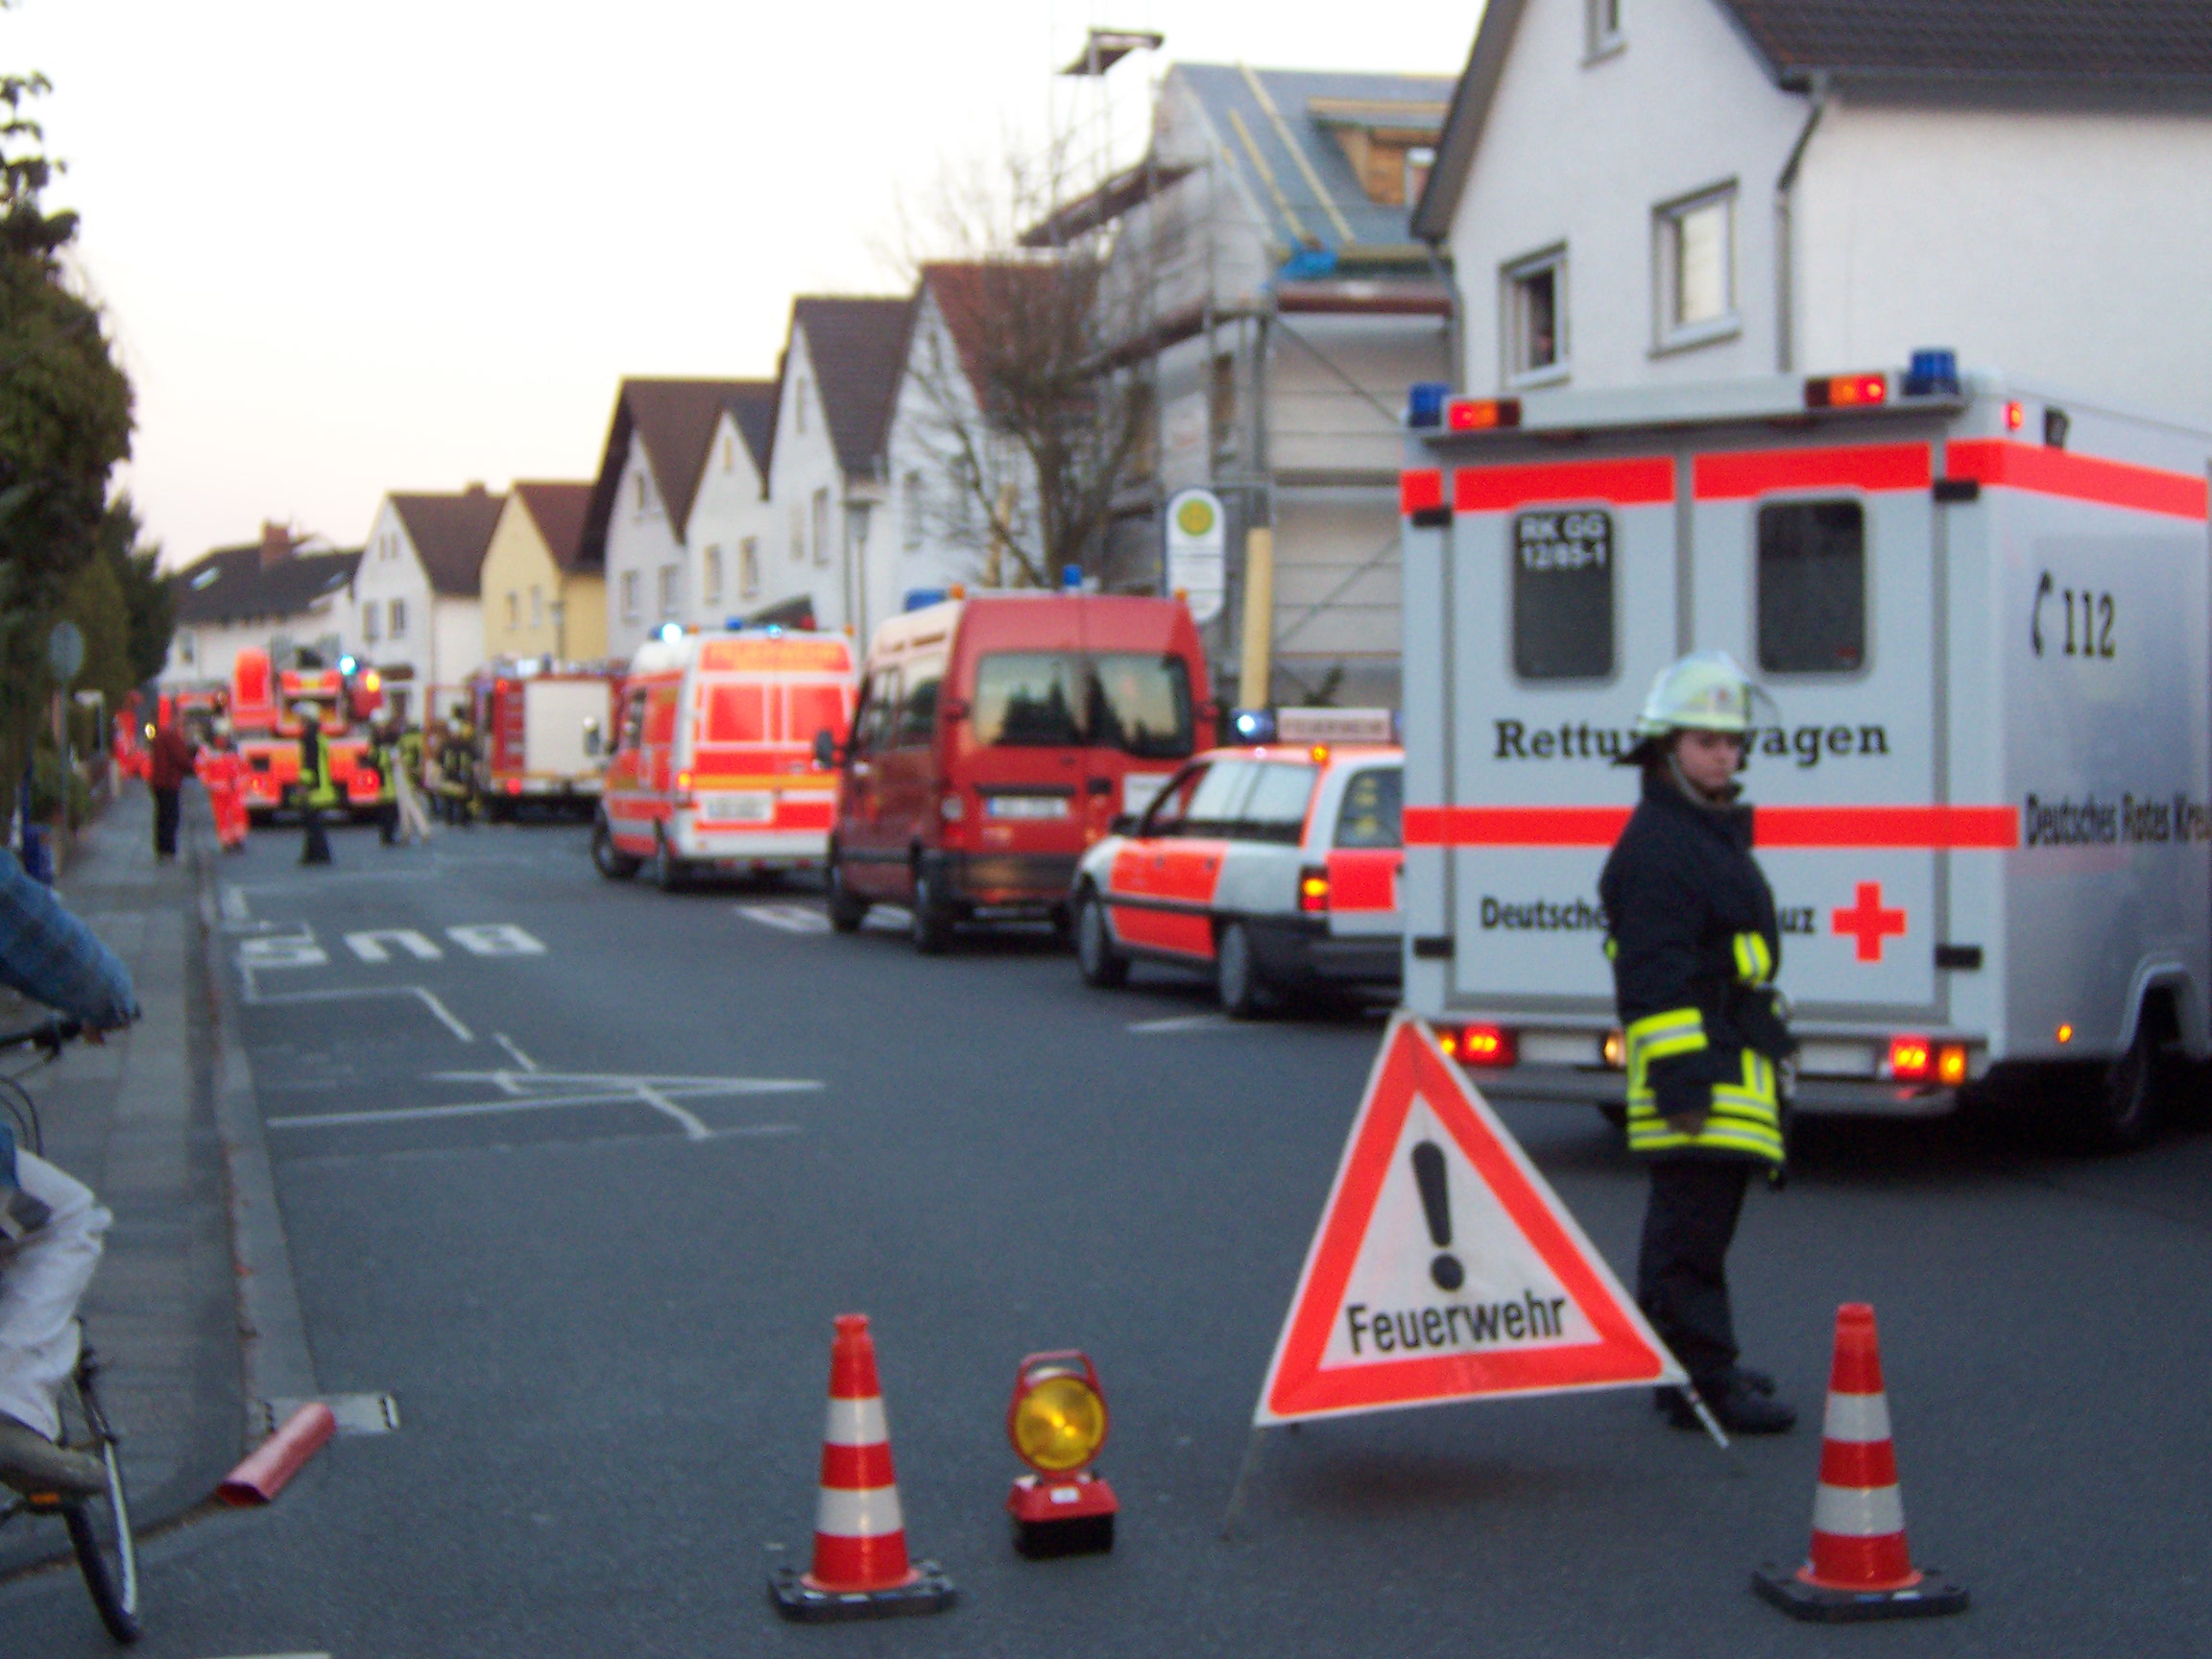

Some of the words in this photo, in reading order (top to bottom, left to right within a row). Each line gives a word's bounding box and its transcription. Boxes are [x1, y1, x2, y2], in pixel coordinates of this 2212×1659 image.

[2062, 589, 2116, 657] 112
[1494, 719, 1889, 766] Rettuagen
[236, 923, 548, 969] BUS
[1347, 1288, 1566, 1355] Feuerwehr
